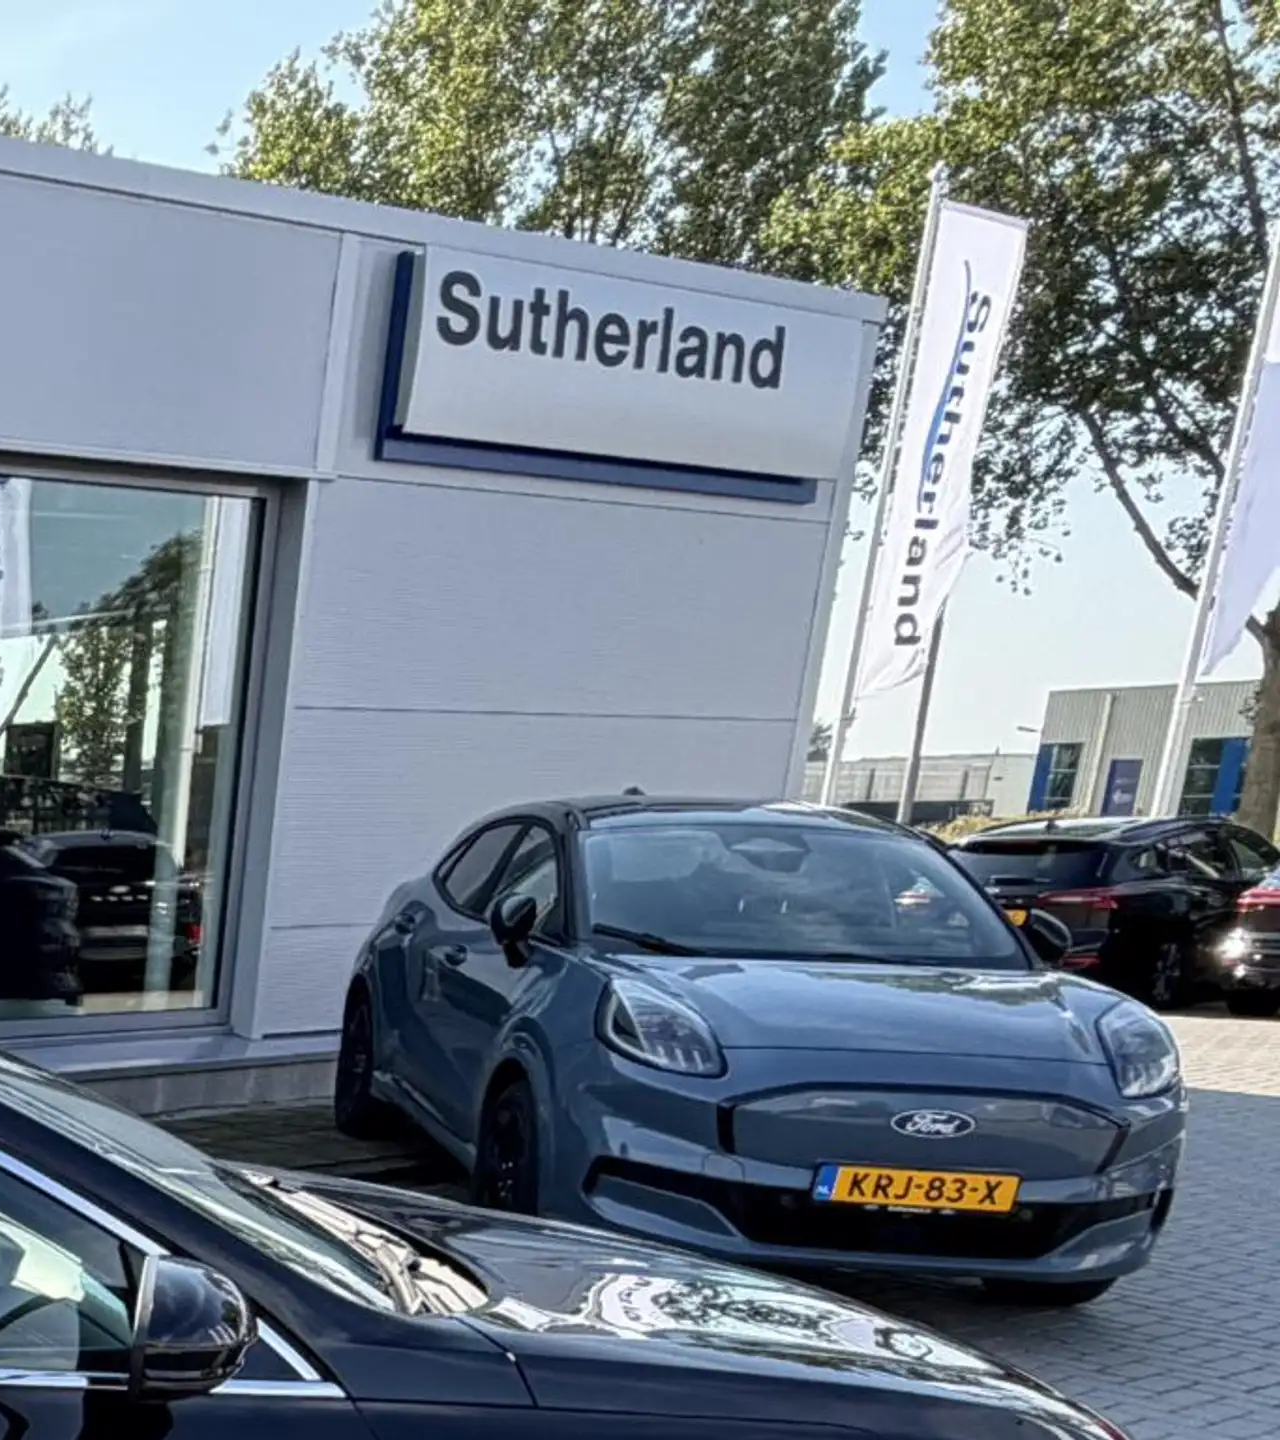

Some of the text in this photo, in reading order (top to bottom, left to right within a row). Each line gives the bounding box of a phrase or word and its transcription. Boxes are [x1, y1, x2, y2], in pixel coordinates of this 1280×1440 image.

[436, 270, 786, 390] Sutherland
[893, 290, 992, 647] Sutherland
[904, 1111, 961, 1134] Ford
[846, 1171, 1003, 1206] KRJ-83-X
